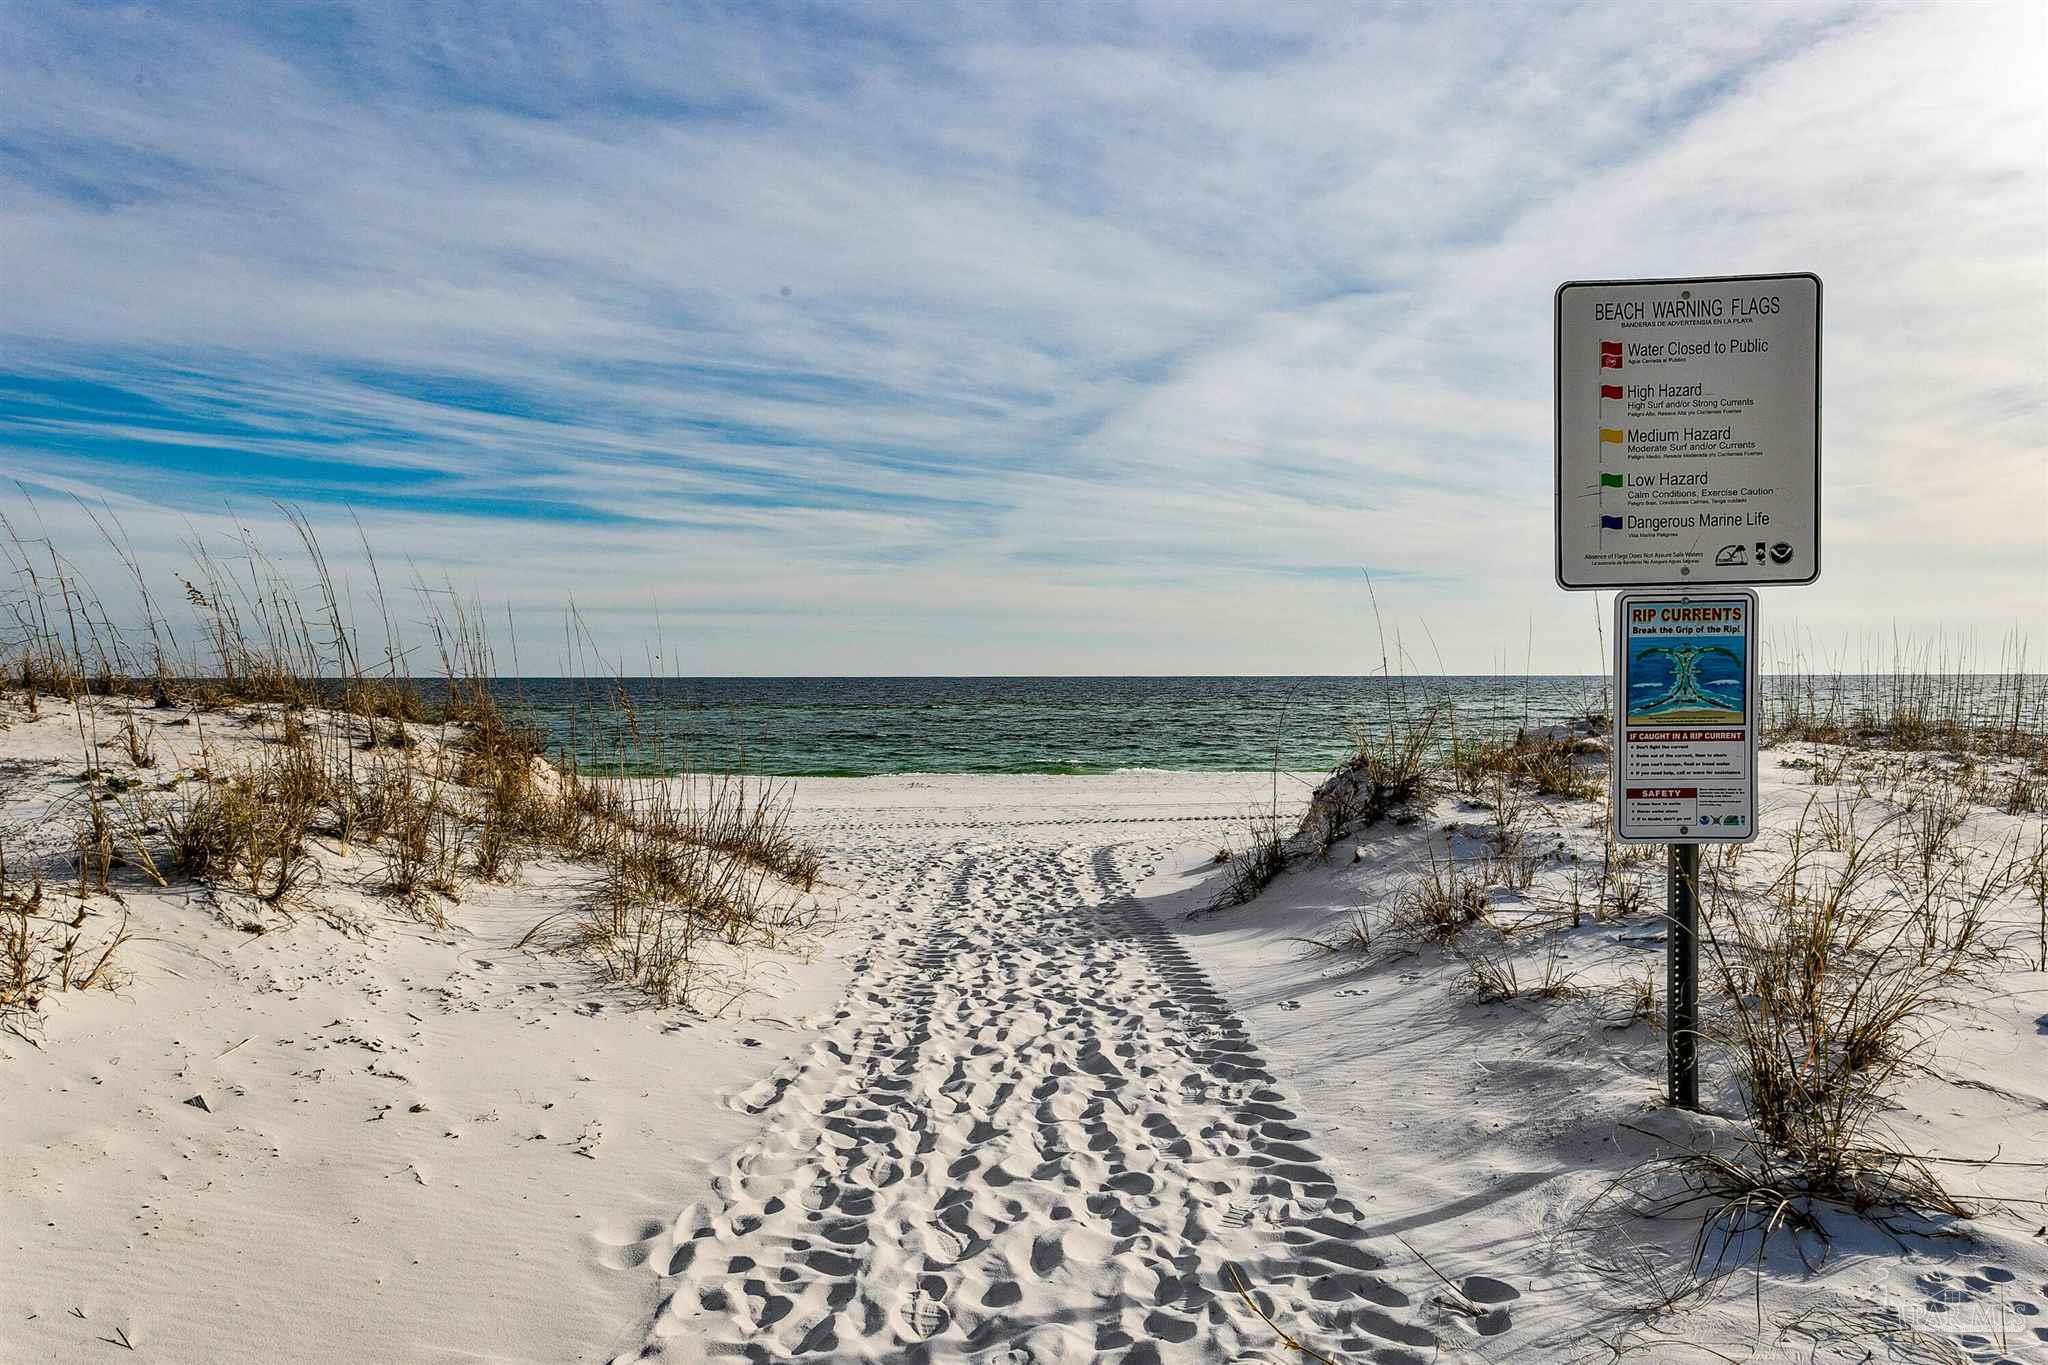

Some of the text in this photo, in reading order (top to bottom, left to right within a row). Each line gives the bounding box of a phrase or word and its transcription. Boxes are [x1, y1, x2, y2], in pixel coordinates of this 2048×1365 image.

[1595, 296, 1780, 321] BEACH WARNING FLAGS
[1628, 338, 1769, 356] Water Closed to Public
[1627, 382, 1702, 401] High Hazard
[1627, 398, 1754, 410] High Surf and/or Strong Currents
[1627, 426, 1731, 442] Medium Hazard
[1627, 440, 1756, 453] Moderate Surf and/or Currents
[1627, 471, 1708, 487] Low Hazard
[1627, 490, 1649, 499] Calm
[1701, 488, 1738, 497] Exercise
[1740, 487, 1774, 496] Caution
[1627, 511, 1770, 531] Dangerous Marine Life
[1632, 607, 1741, 622] RIP CURRENTS
[1632, 624, 1740, 635] Break the Grip of the Rip!
[1682, 732, 1688, 740] A
[1689, 732, 1703, 740] RIP
[1704, 732, 1741, 740] CURRENT
[1641, 790, 1681, 798] SAFETY
